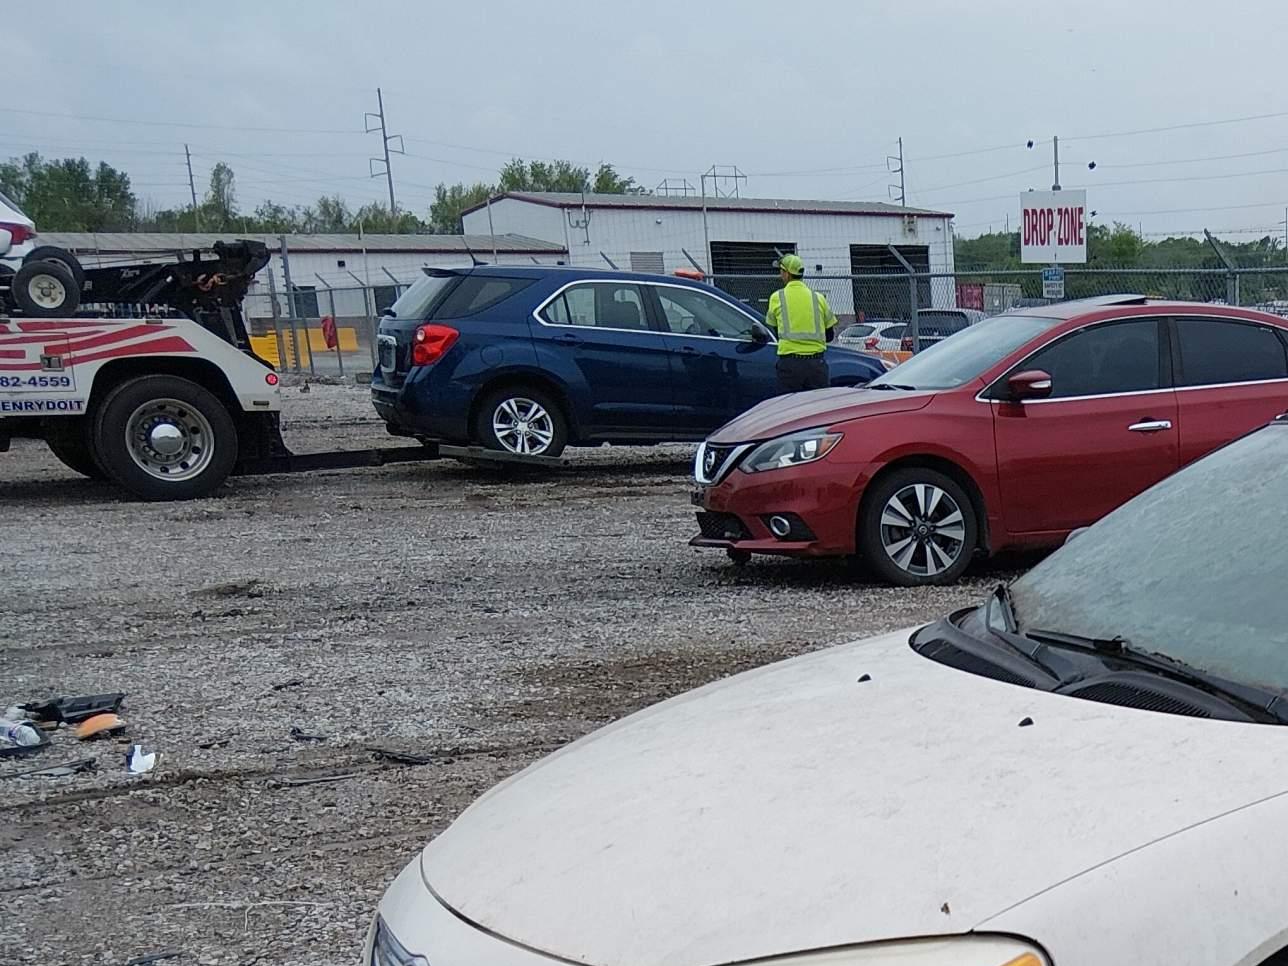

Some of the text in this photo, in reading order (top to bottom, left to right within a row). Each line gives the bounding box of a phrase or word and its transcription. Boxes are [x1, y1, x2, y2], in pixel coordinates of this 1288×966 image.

[1023, 207, 1084, 246] DROP ZONE
[0, 376, 70, 387] 82-4559
